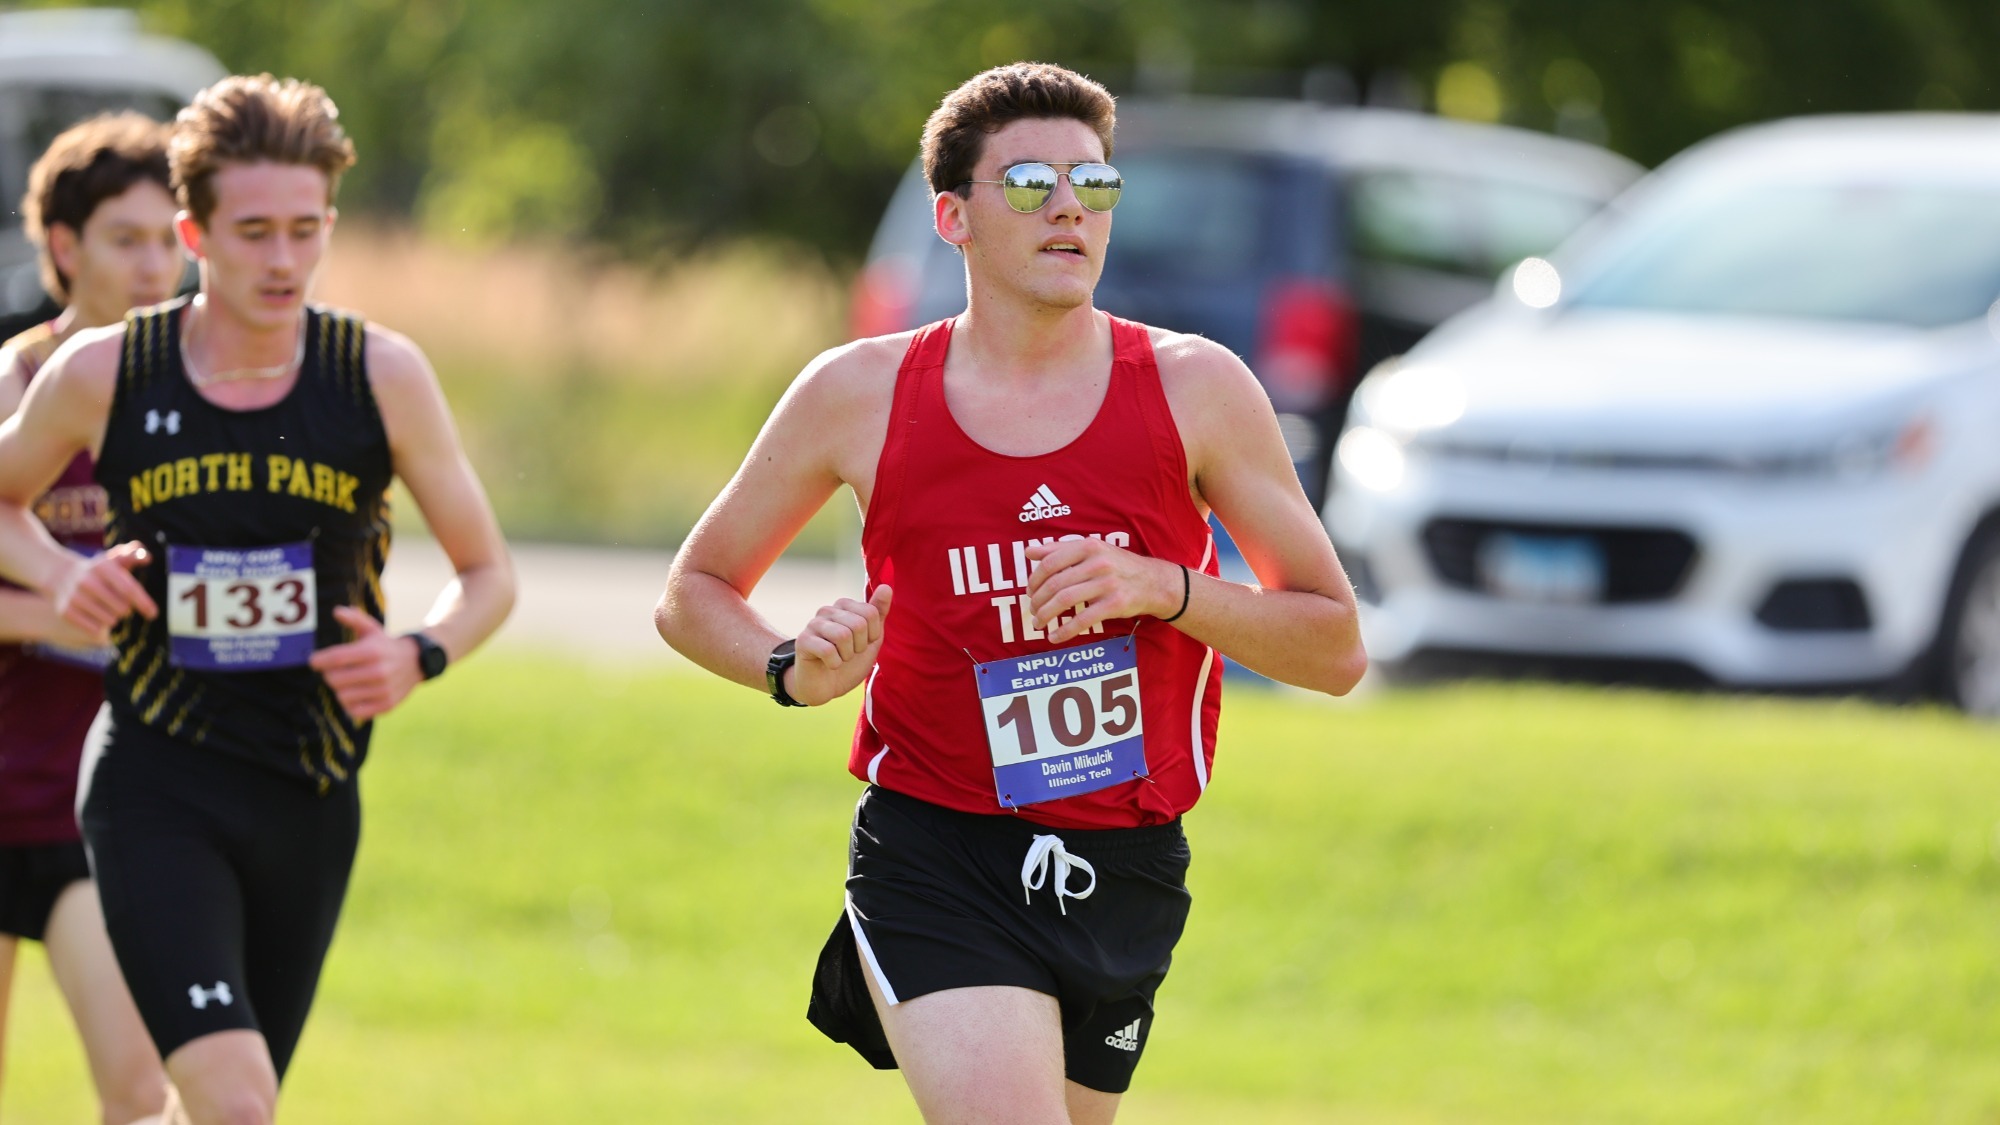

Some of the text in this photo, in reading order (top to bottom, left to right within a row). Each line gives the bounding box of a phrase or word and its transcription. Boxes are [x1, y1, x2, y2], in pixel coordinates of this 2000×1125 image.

[130, 453, 252, 513] NORTH
[266, 454, 359, 513] PARK
[1018, 505, 1071, 522] adidas
[948, 531, 1130, 595] ILLI
[181, 579, 308, 629] 133
[1017, 646, 1105, 673] NPU/CUC
[1011, 661, 1114, 690] Early Invite
[996, 673, 1137, 756] 105
[1041, 749, 1113, 776] Davin Mikulcik
[1048, 767, 1112, 788] Illinois Tech
